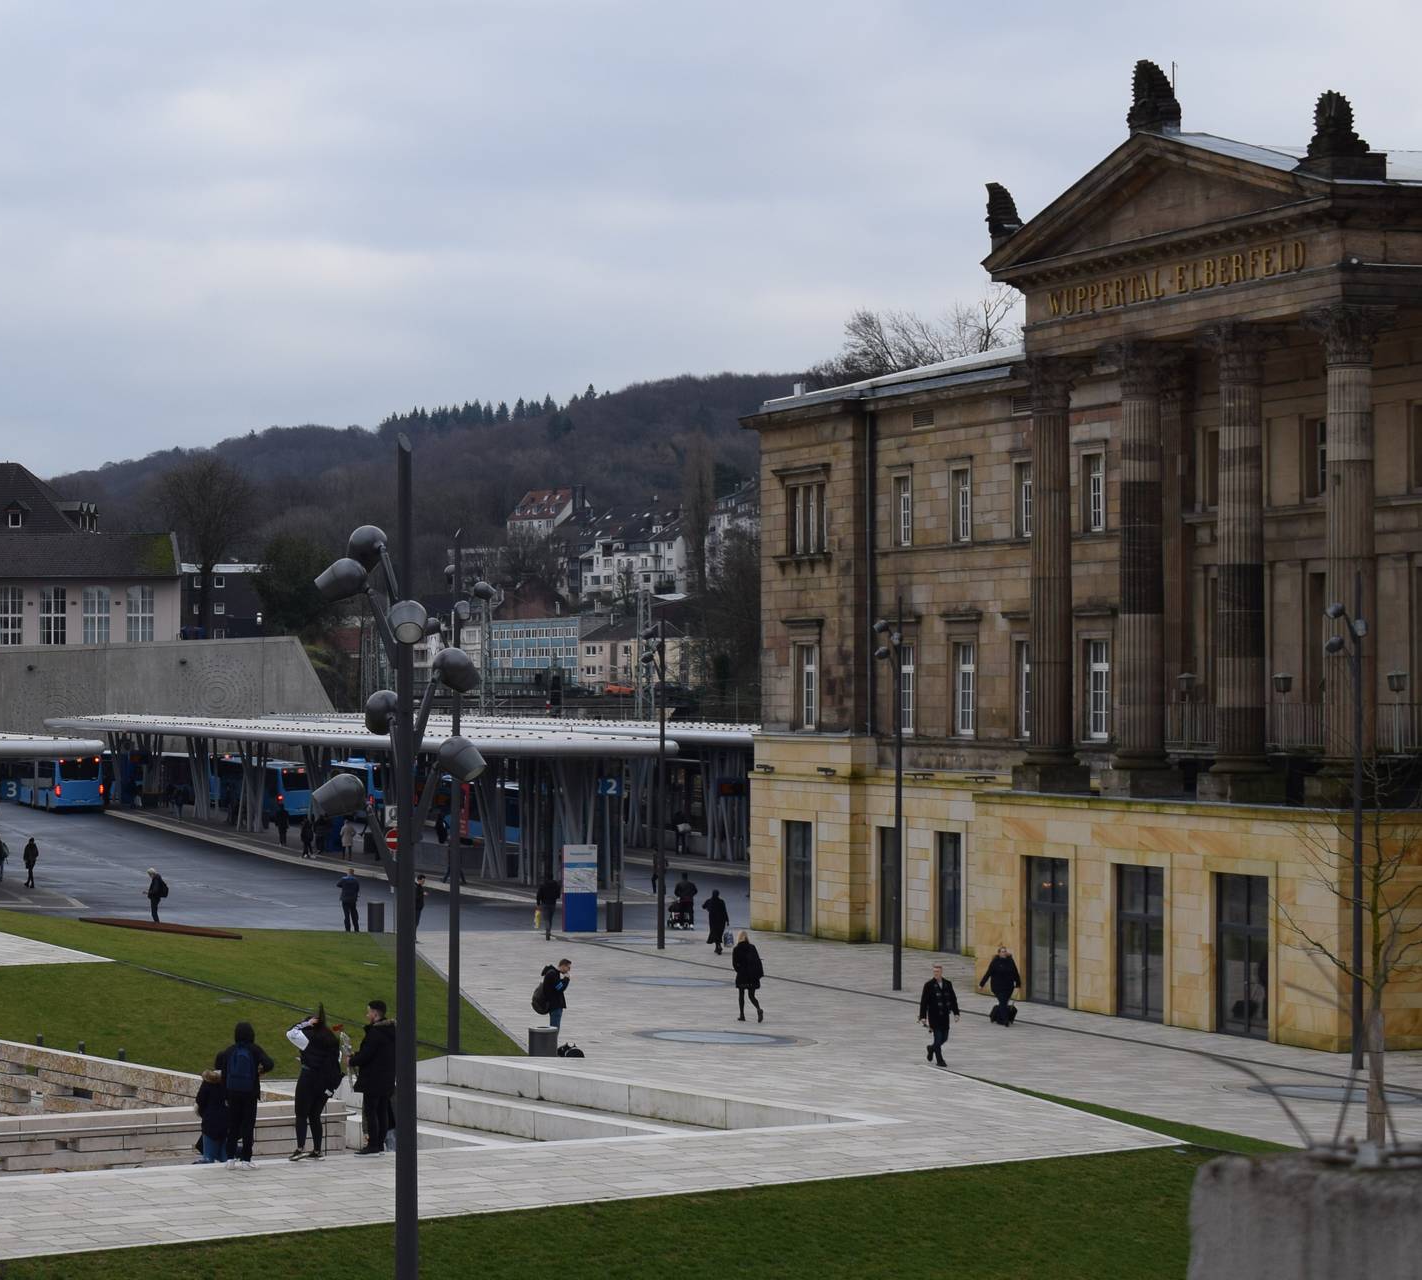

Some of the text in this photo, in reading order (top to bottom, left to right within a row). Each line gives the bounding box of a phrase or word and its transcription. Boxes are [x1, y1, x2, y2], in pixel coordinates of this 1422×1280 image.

[1047, 240, 1306, 316] WUPPERTAL ELBERFELD
[6, 780, 18, 798] 3
[606, 778, 618, 794] 2
